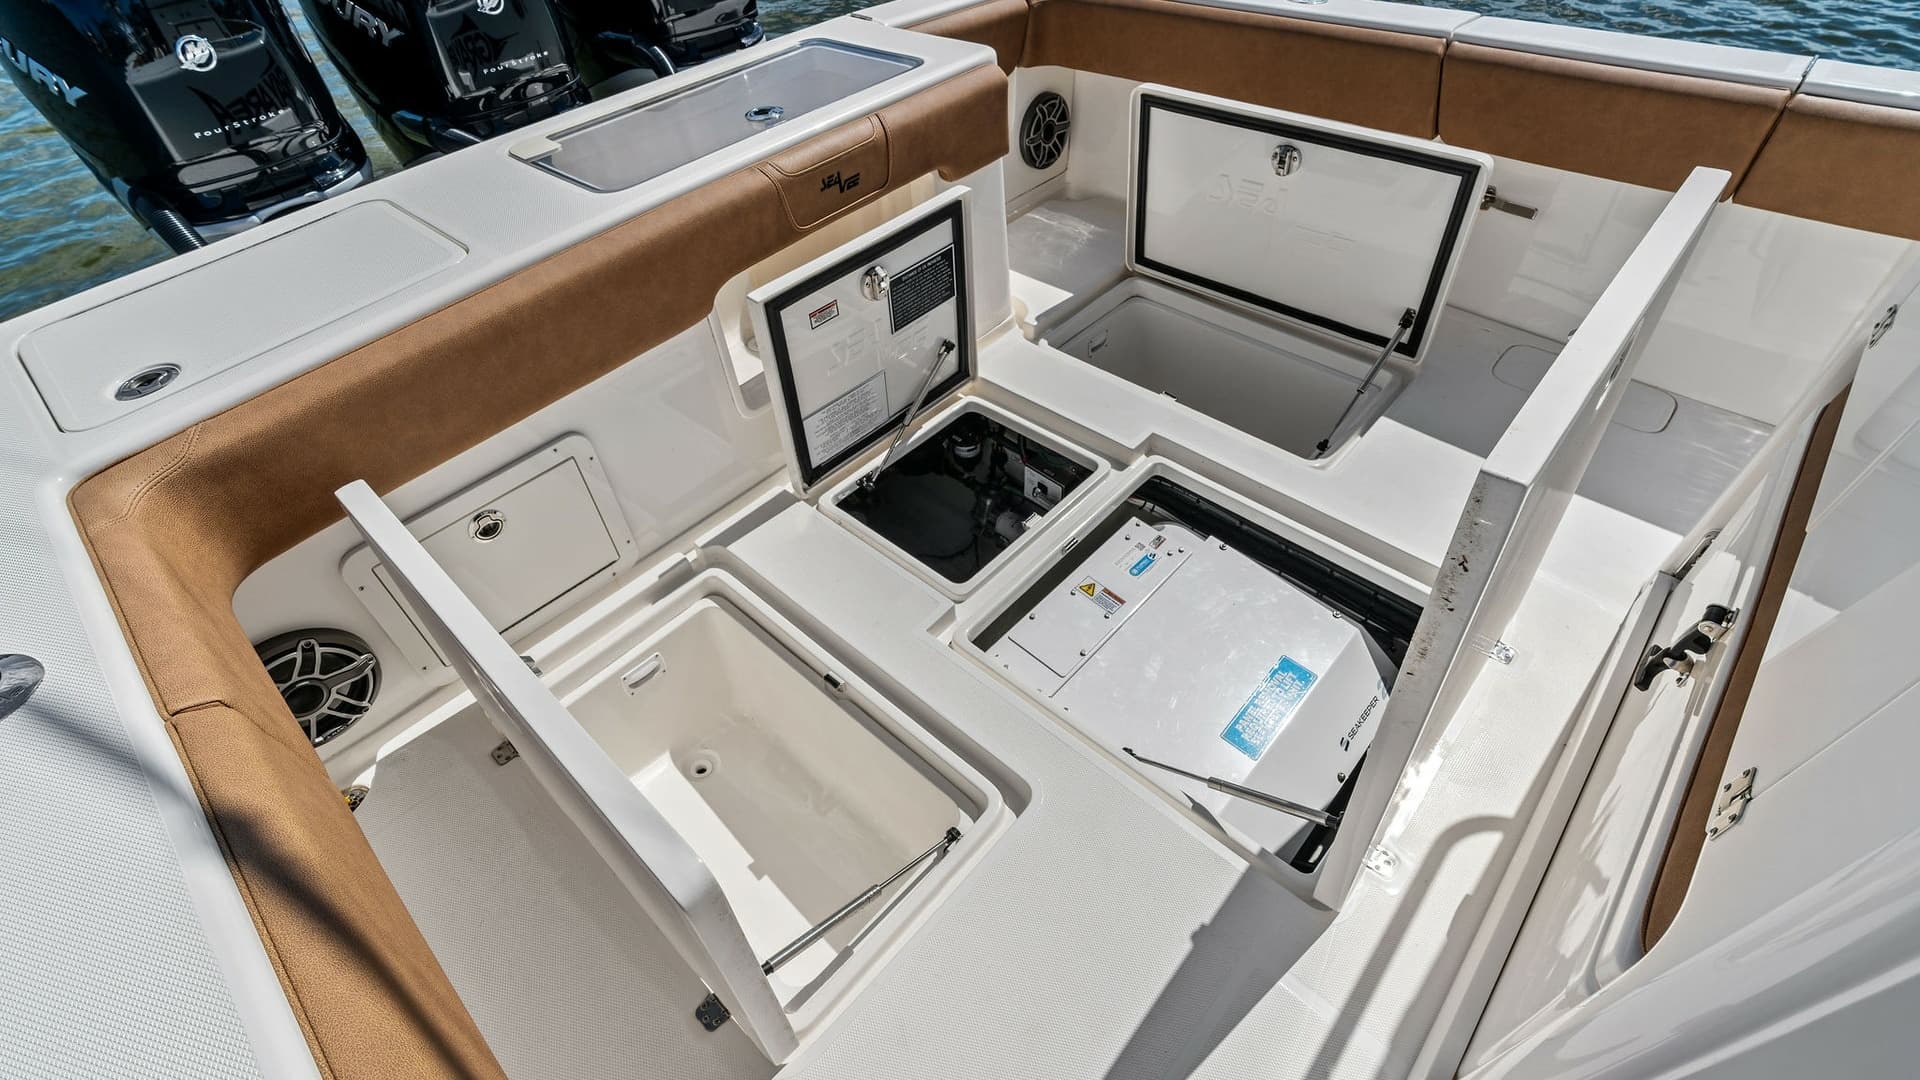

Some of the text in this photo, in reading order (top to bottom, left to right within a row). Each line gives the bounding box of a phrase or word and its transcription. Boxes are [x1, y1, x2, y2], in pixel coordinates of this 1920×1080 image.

[322, 0, 405, 47] URY
[0, 36, 88, 107] URY
[193, 108, 284, 140] FourStroke
[1347, 695, 1379, 741] SEAKEEPER
